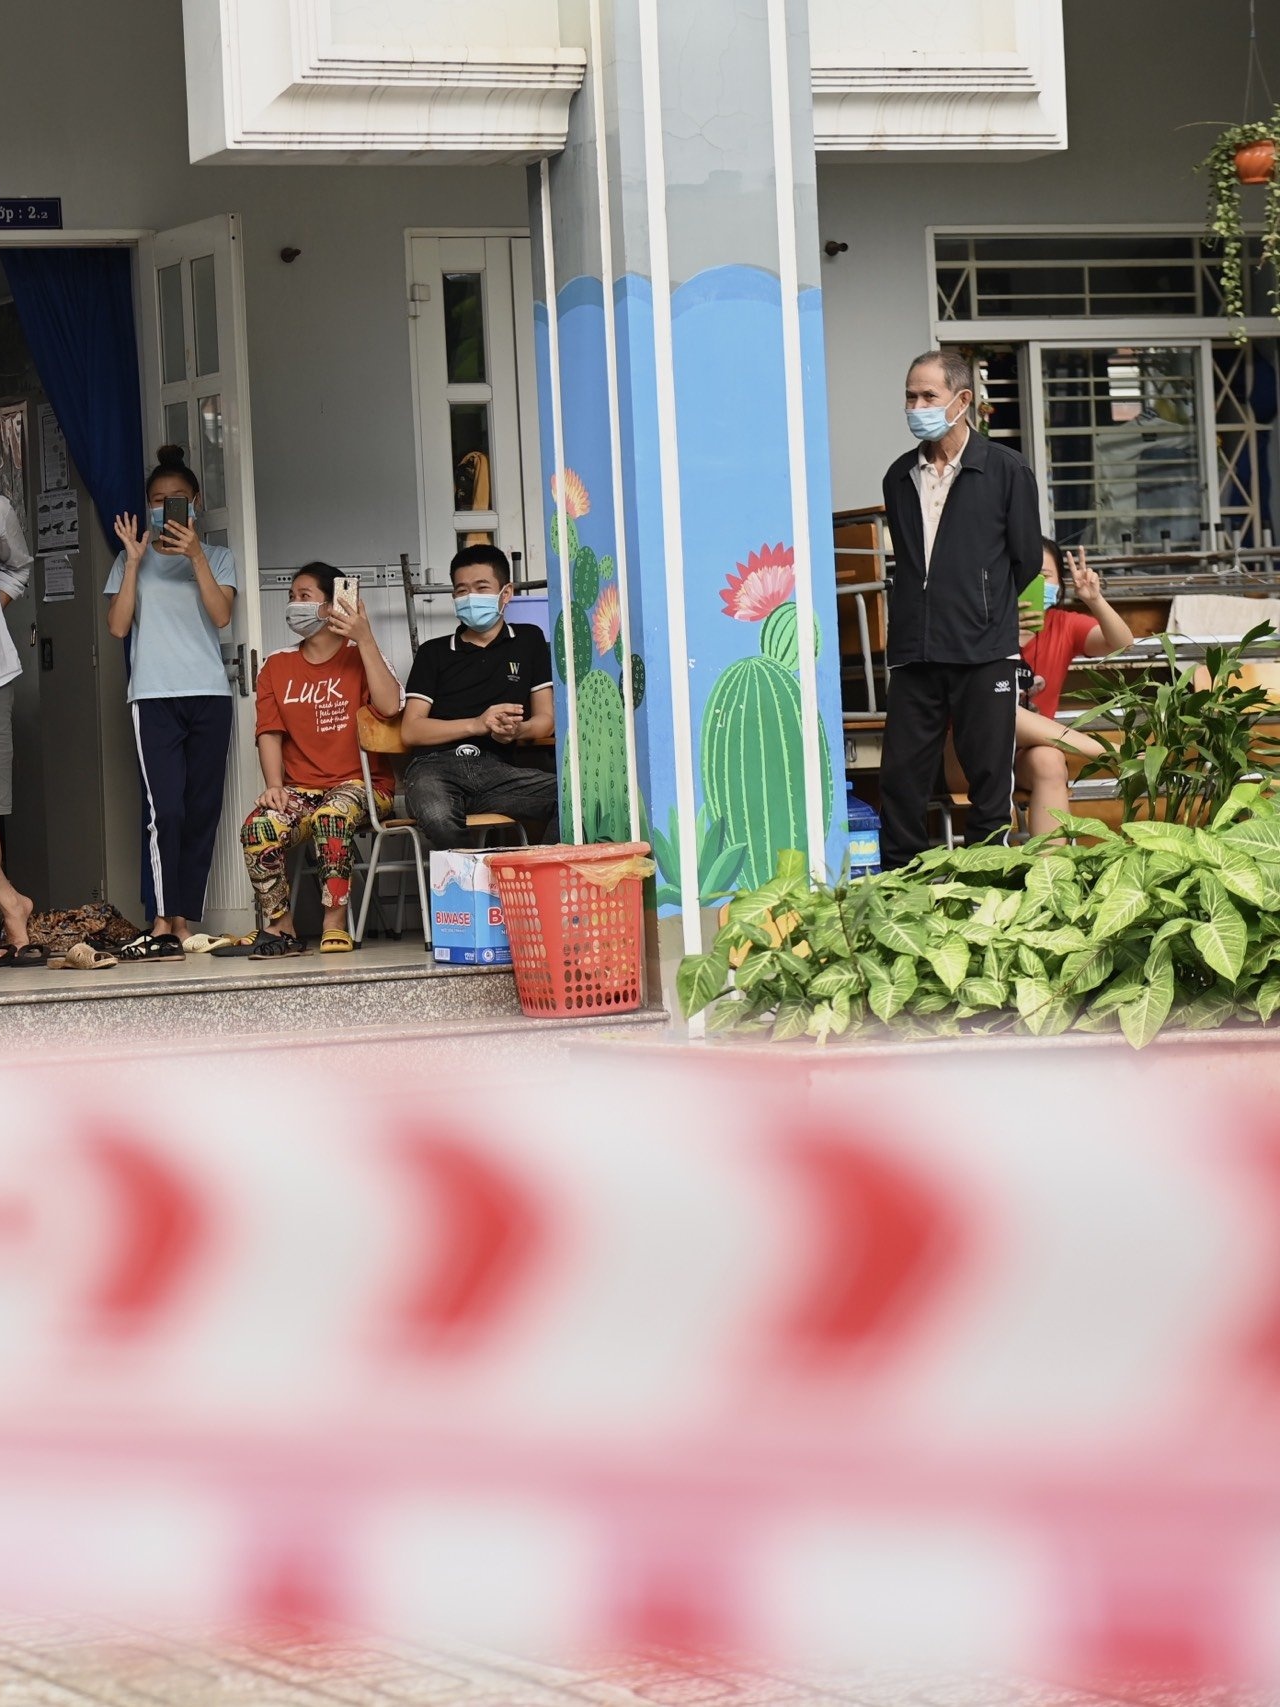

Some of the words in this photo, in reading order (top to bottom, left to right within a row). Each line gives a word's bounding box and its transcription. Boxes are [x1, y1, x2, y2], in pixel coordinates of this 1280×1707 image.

[28, 205, 49, 219] 2.2
[283, 678, 343, 704] LUCK
[318, 701, 333, 709] need
[334, 700, 349, 708] sleep
[320, 724, 336, 733] want
[336, 723, 348, 732] you
[436, 912, 471, 926] BIWASE
